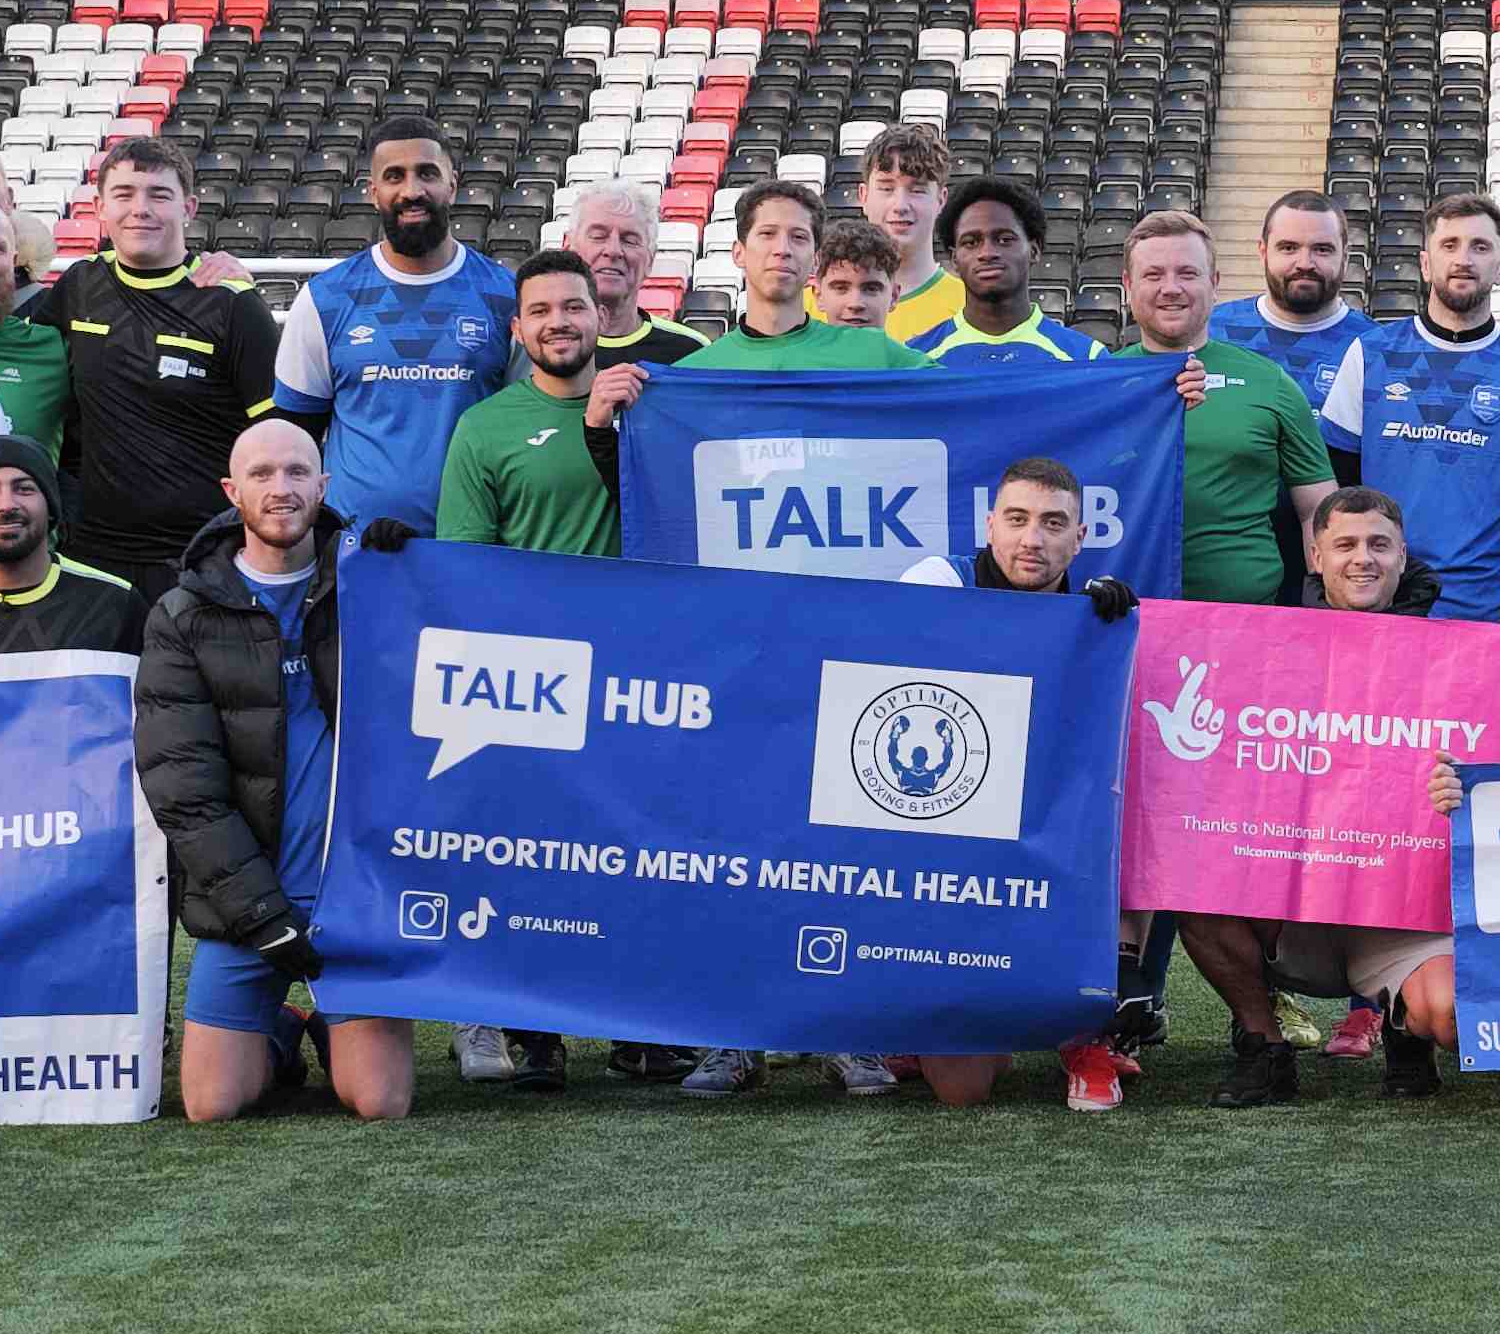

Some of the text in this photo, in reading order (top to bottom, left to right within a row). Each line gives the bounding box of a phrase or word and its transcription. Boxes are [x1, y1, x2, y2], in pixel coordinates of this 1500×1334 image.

[377, 364, 475, 381] AutoTrader
[1399, 421, 1488, 447] AutoTrader
[721, 486, 924, 550] TALK
[434, 661, 713, 731] TALK HUB
[873, 688, 971, 726] OPTIMAL
[1237, 705, 1487, 752] COMMUNITY
[1236, 740, 1332, 775] FUND
[862, 767, 975, 812] BOXING FITNESS
[1182, 815, 1447, 851] Thanks to National Lottery players
[390, 826, 1050, 910] SUPPORTING MEN'S MENTAL HEALTH
[1234, 844, 1385, 868] tnlcommunityfund.org.uk
[856, 942, 1012, 969] @OPTIMAL BOXING
